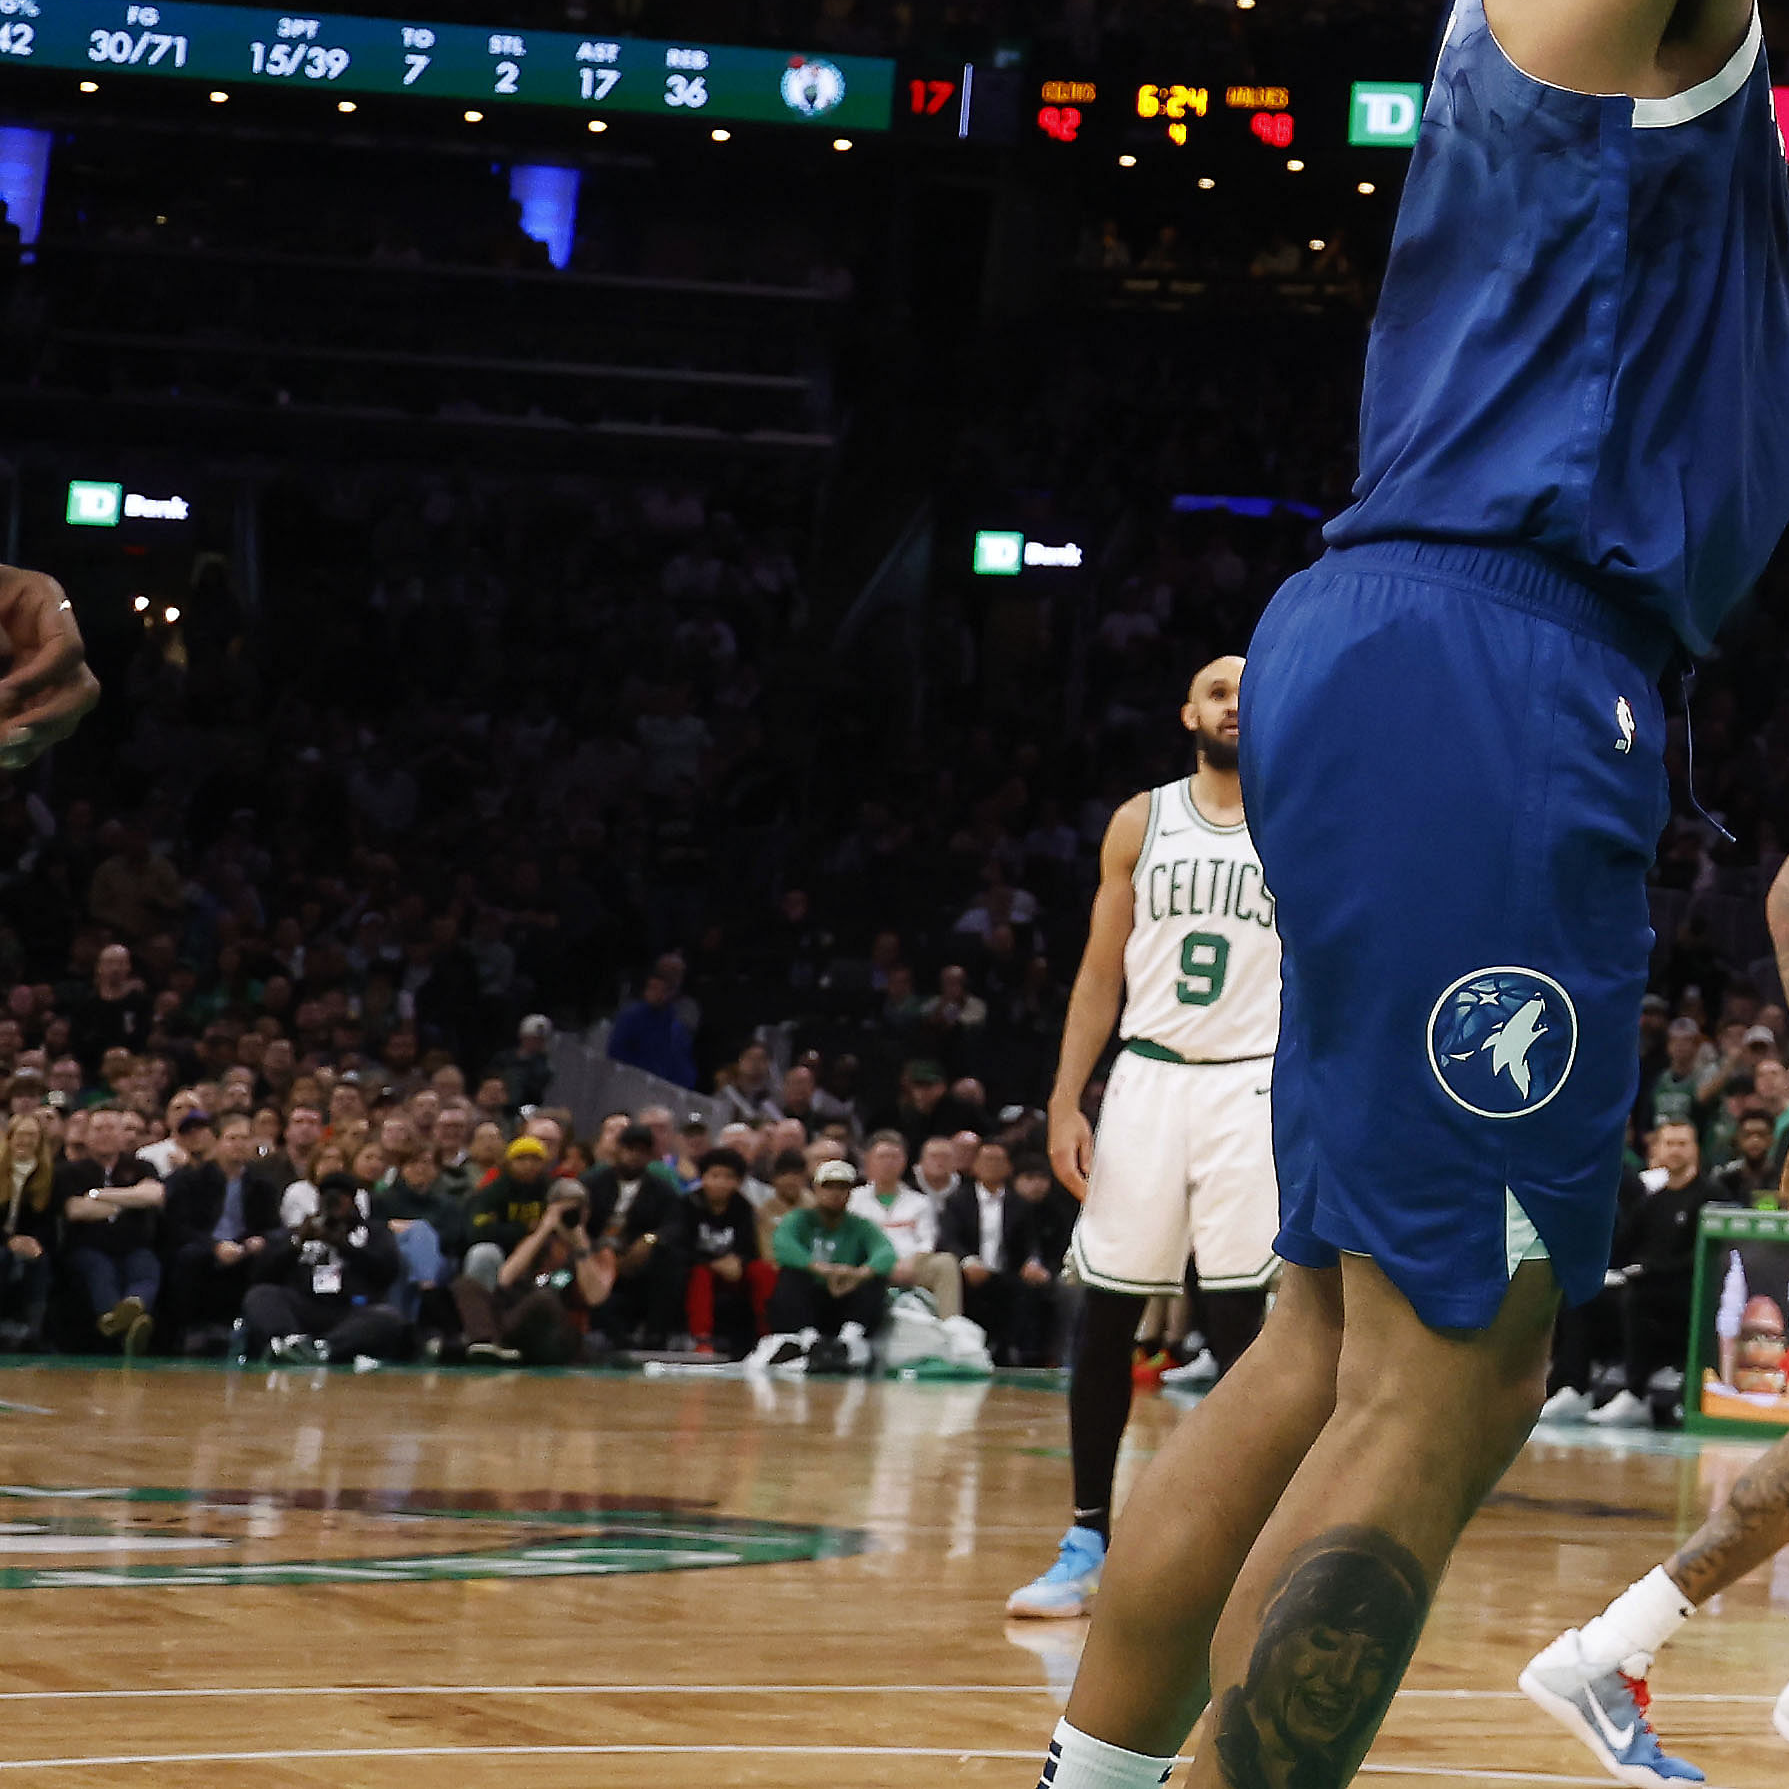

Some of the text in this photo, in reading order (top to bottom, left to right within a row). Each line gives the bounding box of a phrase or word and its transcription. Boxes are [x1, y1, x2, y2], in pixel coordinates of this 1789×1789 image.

[88, 28, 189, 69] 30/71
[249, 41, 351, 81] 15/39
[401, 52, 432, 86] 7
[493, 59, 521, 94] 2
[579, 66, 622, 101] 17
[663, 73, 710, 108] 36
[908, 79, 957, 116] 17
[1354, 90, 1415, 135] TD
[1150, 858, 1275, 927] CELTICS
[1176, 930, 1231, 1007] 9
